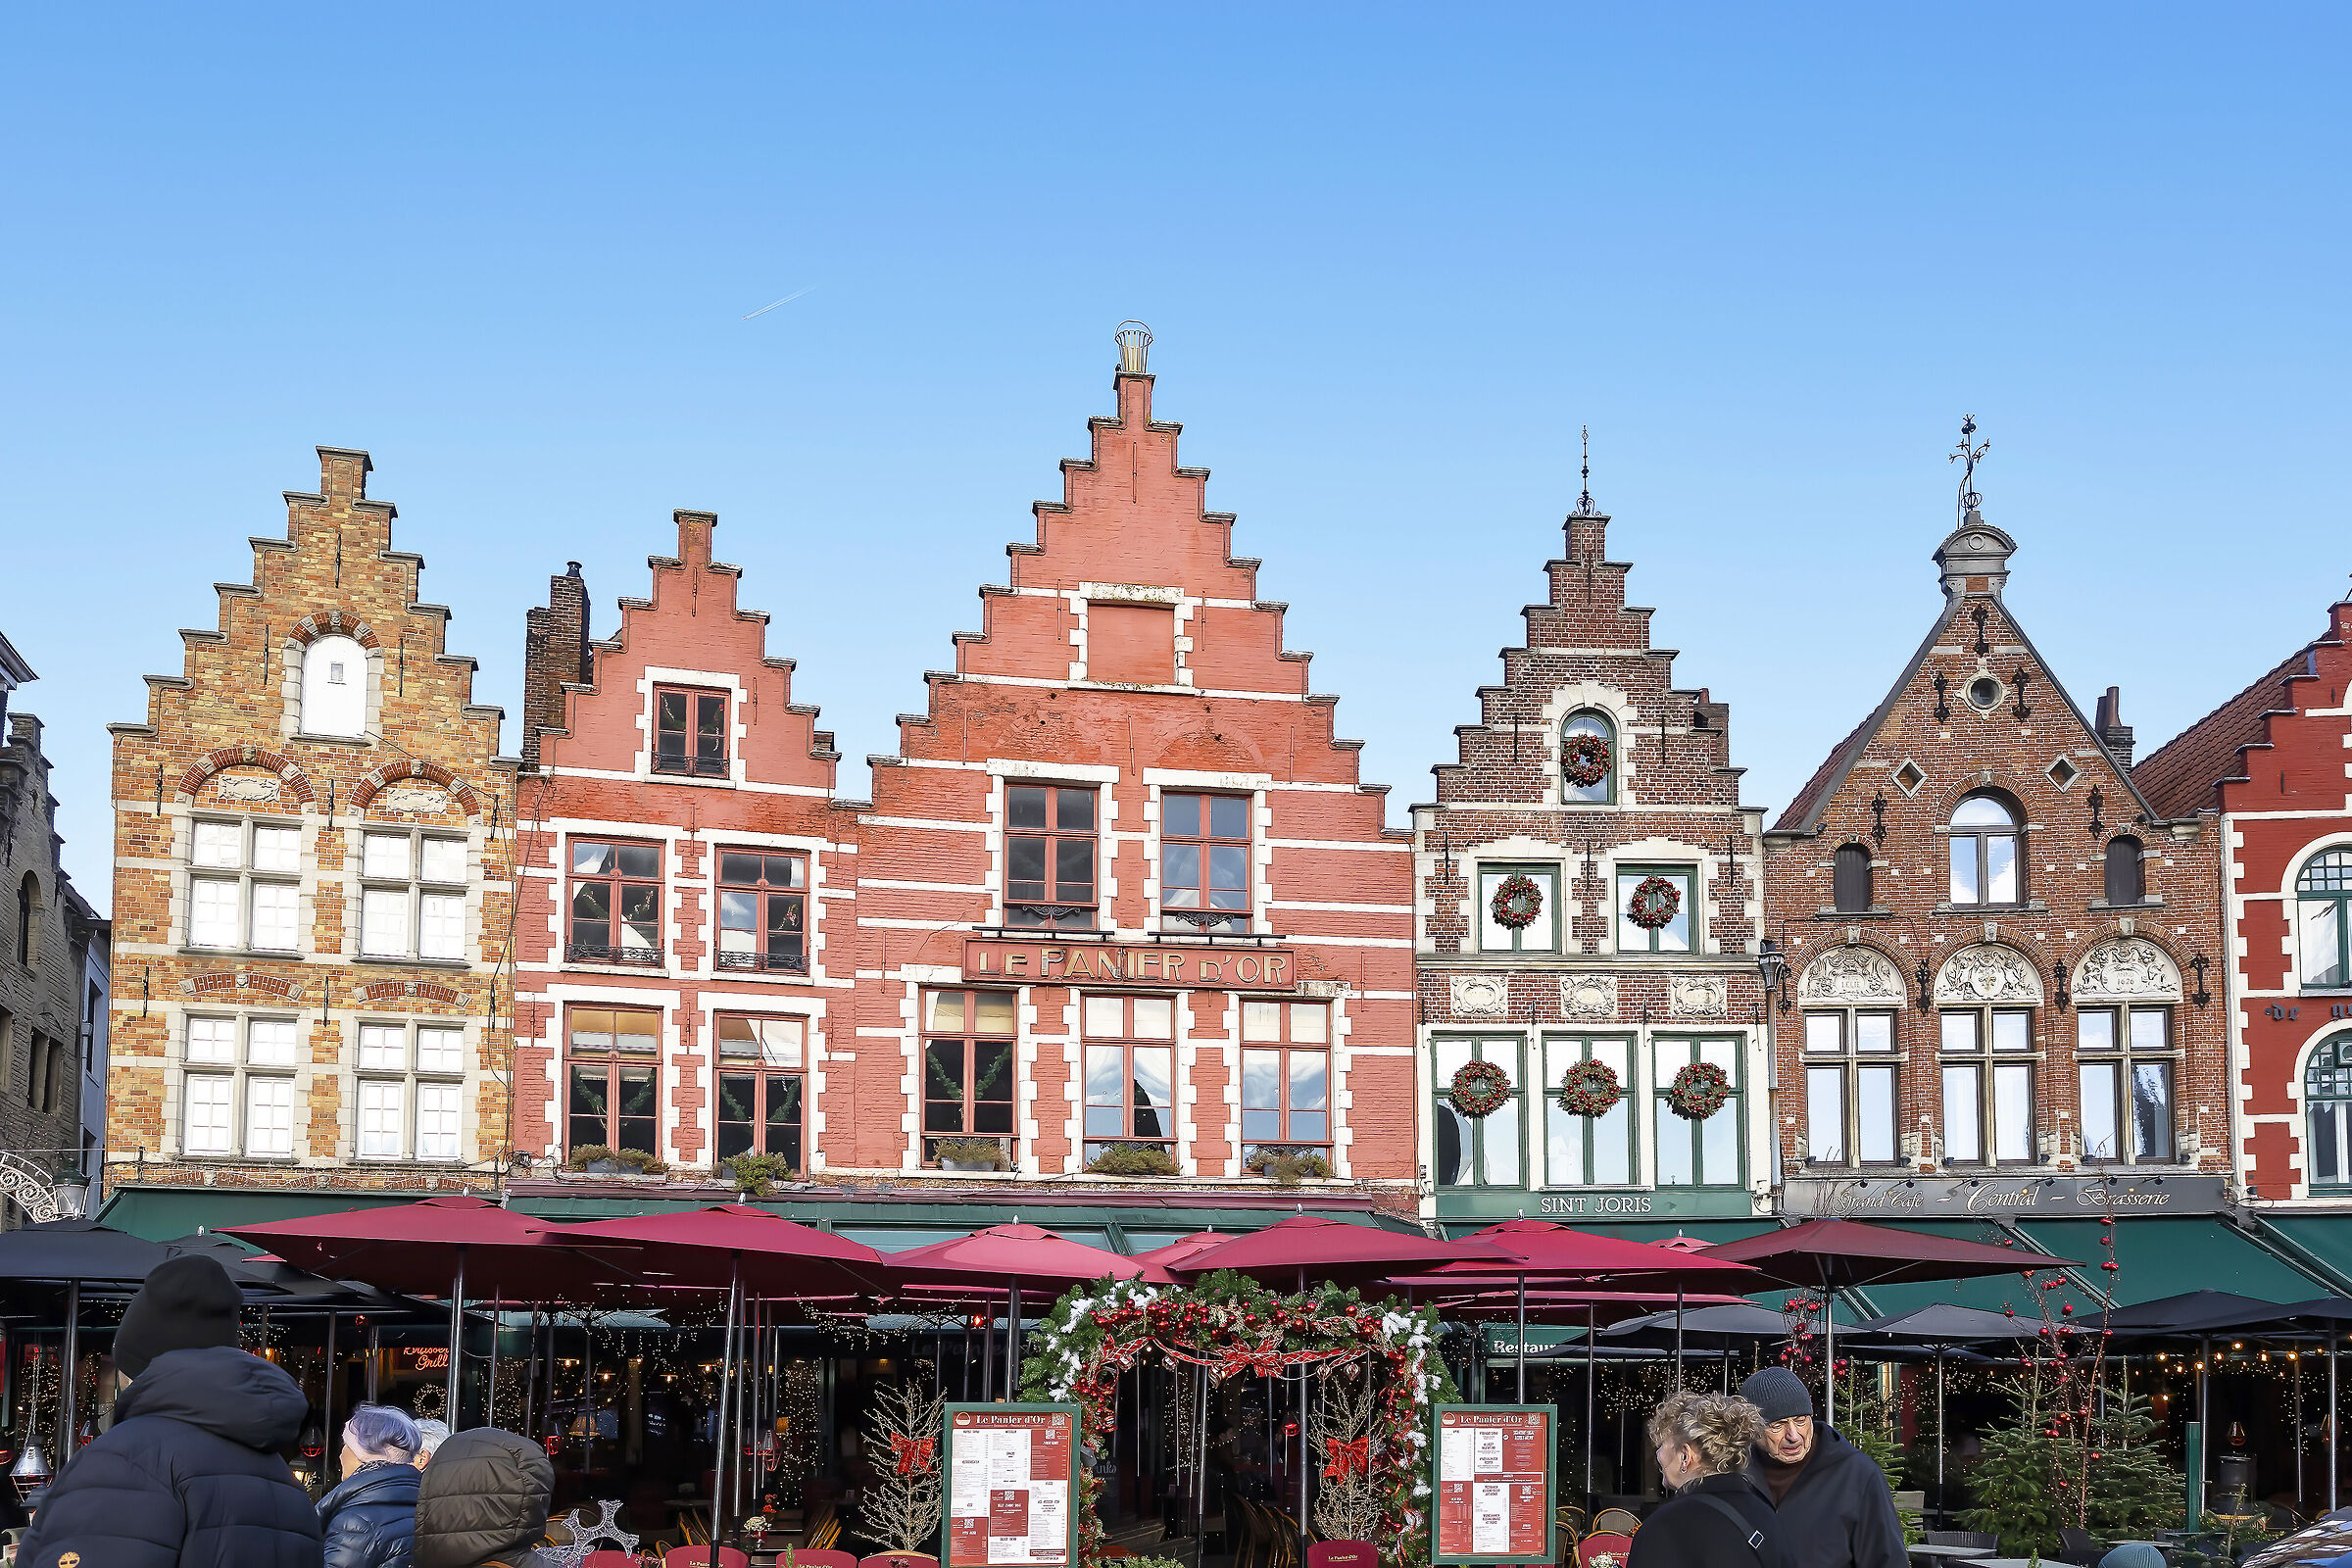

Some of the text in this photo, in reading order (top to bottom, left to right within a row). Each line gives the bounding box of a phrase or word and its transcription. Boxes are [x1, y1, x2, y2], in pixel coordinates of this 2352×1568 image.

[979, 948, 1287, 984] LE PANIER D'OR
[1541, 1197, 1651, 1213] SINT JORIS
[1832, 1191, 1887, 1214] Grand
[1964, 1182, 2040, 1213] Central
[2076, 1188, 2171, 1206] Brasserie
[416, 1354, 449, 1370] Grill
[976, 1415, 1046, 1424] Le Panier d'Or
[1460, 1415, 1523, 1424] Le Panier d'Or
